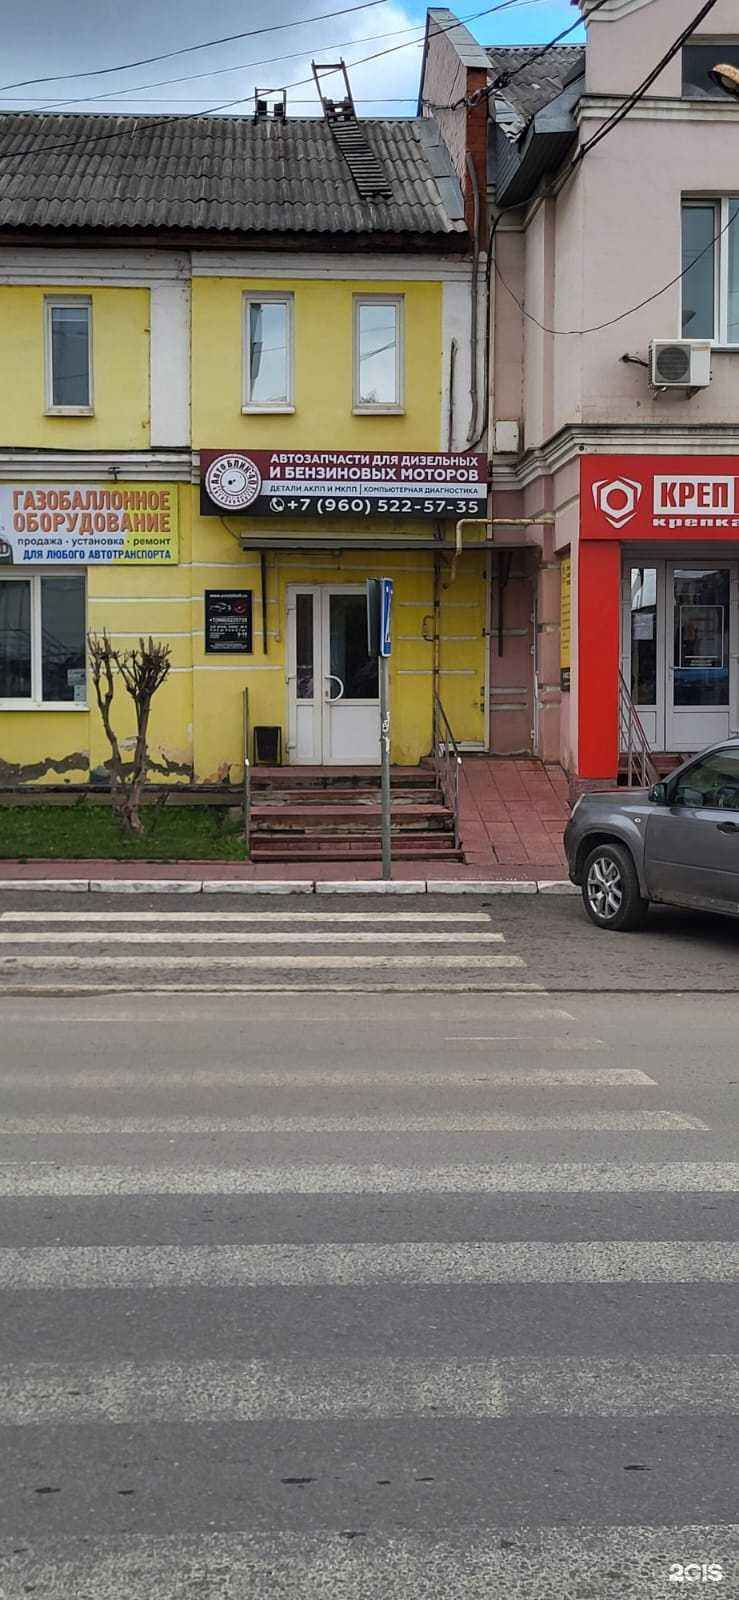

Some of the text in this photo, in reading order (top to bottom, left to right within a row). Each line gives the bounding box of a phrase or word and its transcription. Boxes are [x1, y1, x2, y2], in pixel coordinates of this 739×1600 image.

[270, 454, 478, 466] АВТОЗАПЧАСТИ ДЛЯ ДИЗЕЛЬНЫХ
[269, 467, 479, 481] И БЕНЗИНОВЫХ МОТОРОВ
[12, 490, 171, 511] ГАЗОБАЛЛОННОЕ
[660, 482, 728, 507] КРЕП
[287, 498, 479, 514] +7 (960) 522-57-35
[13, 512, 171, 535] ОБОРУДОВАНИЕ
[17, 537, 171, 547] продажа установка ремонт
[23, 550, 171, 561] ДЛЯ ЛЮБОГО АВТОТРАНСПОРТА
